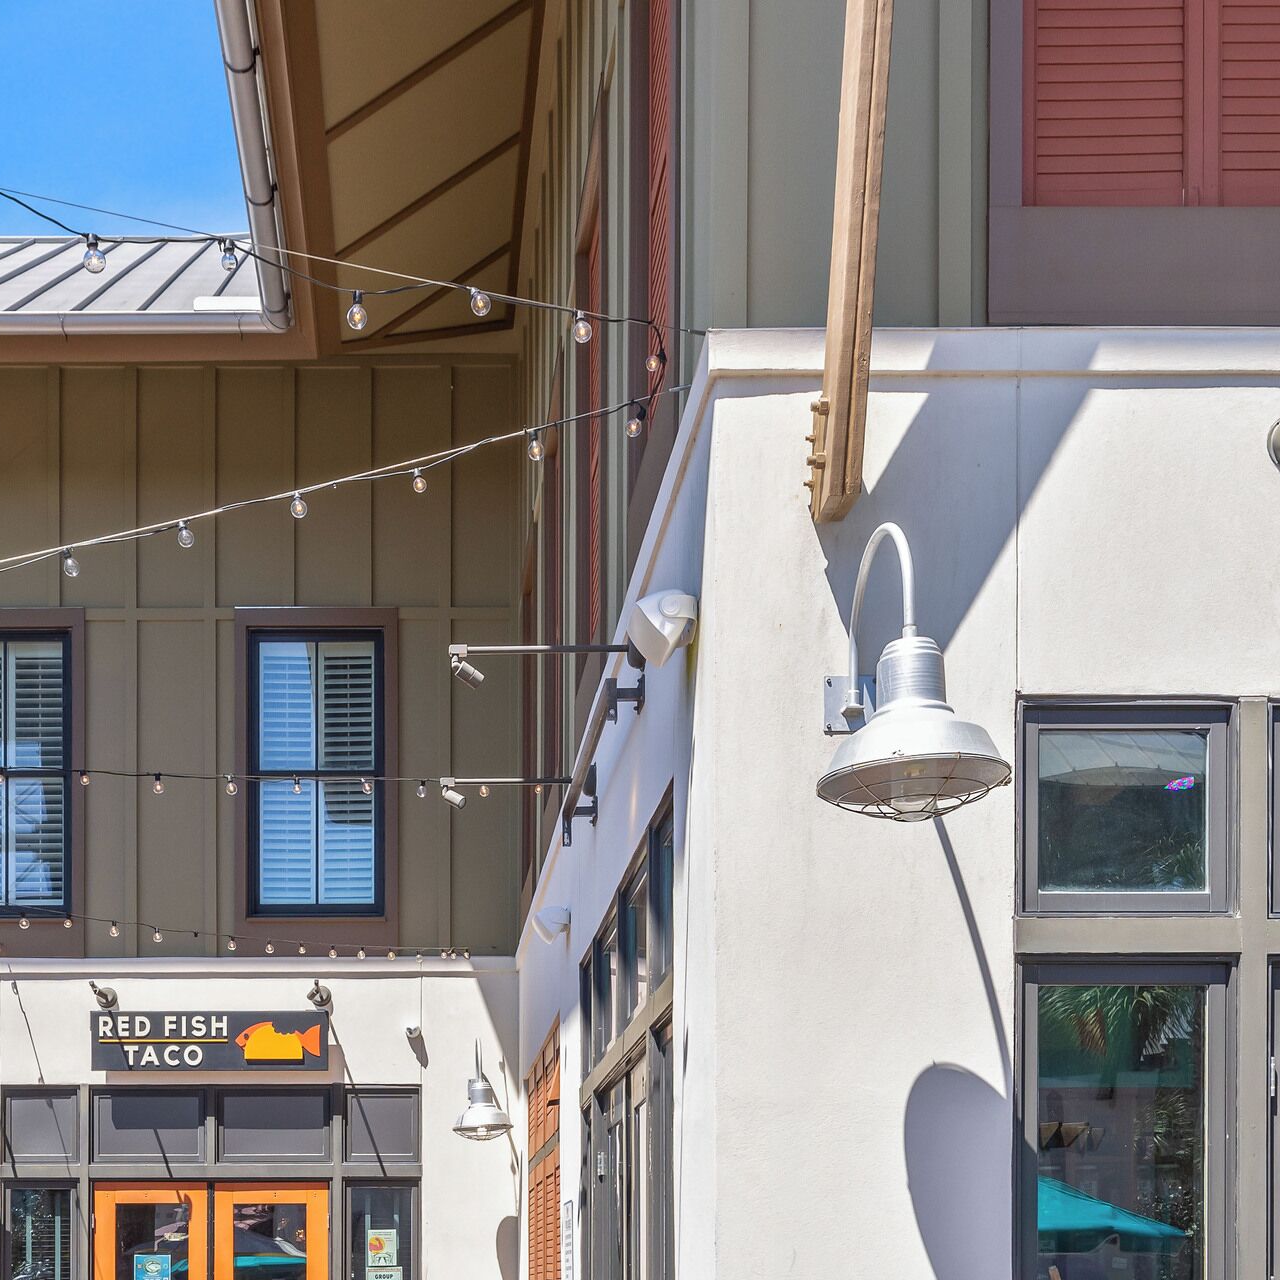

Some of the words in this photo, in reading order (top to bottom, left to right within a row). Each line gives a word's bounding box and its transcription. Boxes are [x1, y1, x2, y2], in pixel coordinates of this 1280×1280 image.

[98, 1015, 151, 1038] RED
[164, 1015, 228, 1038] FISH
[123, 1045, 203, 1067] TACO
